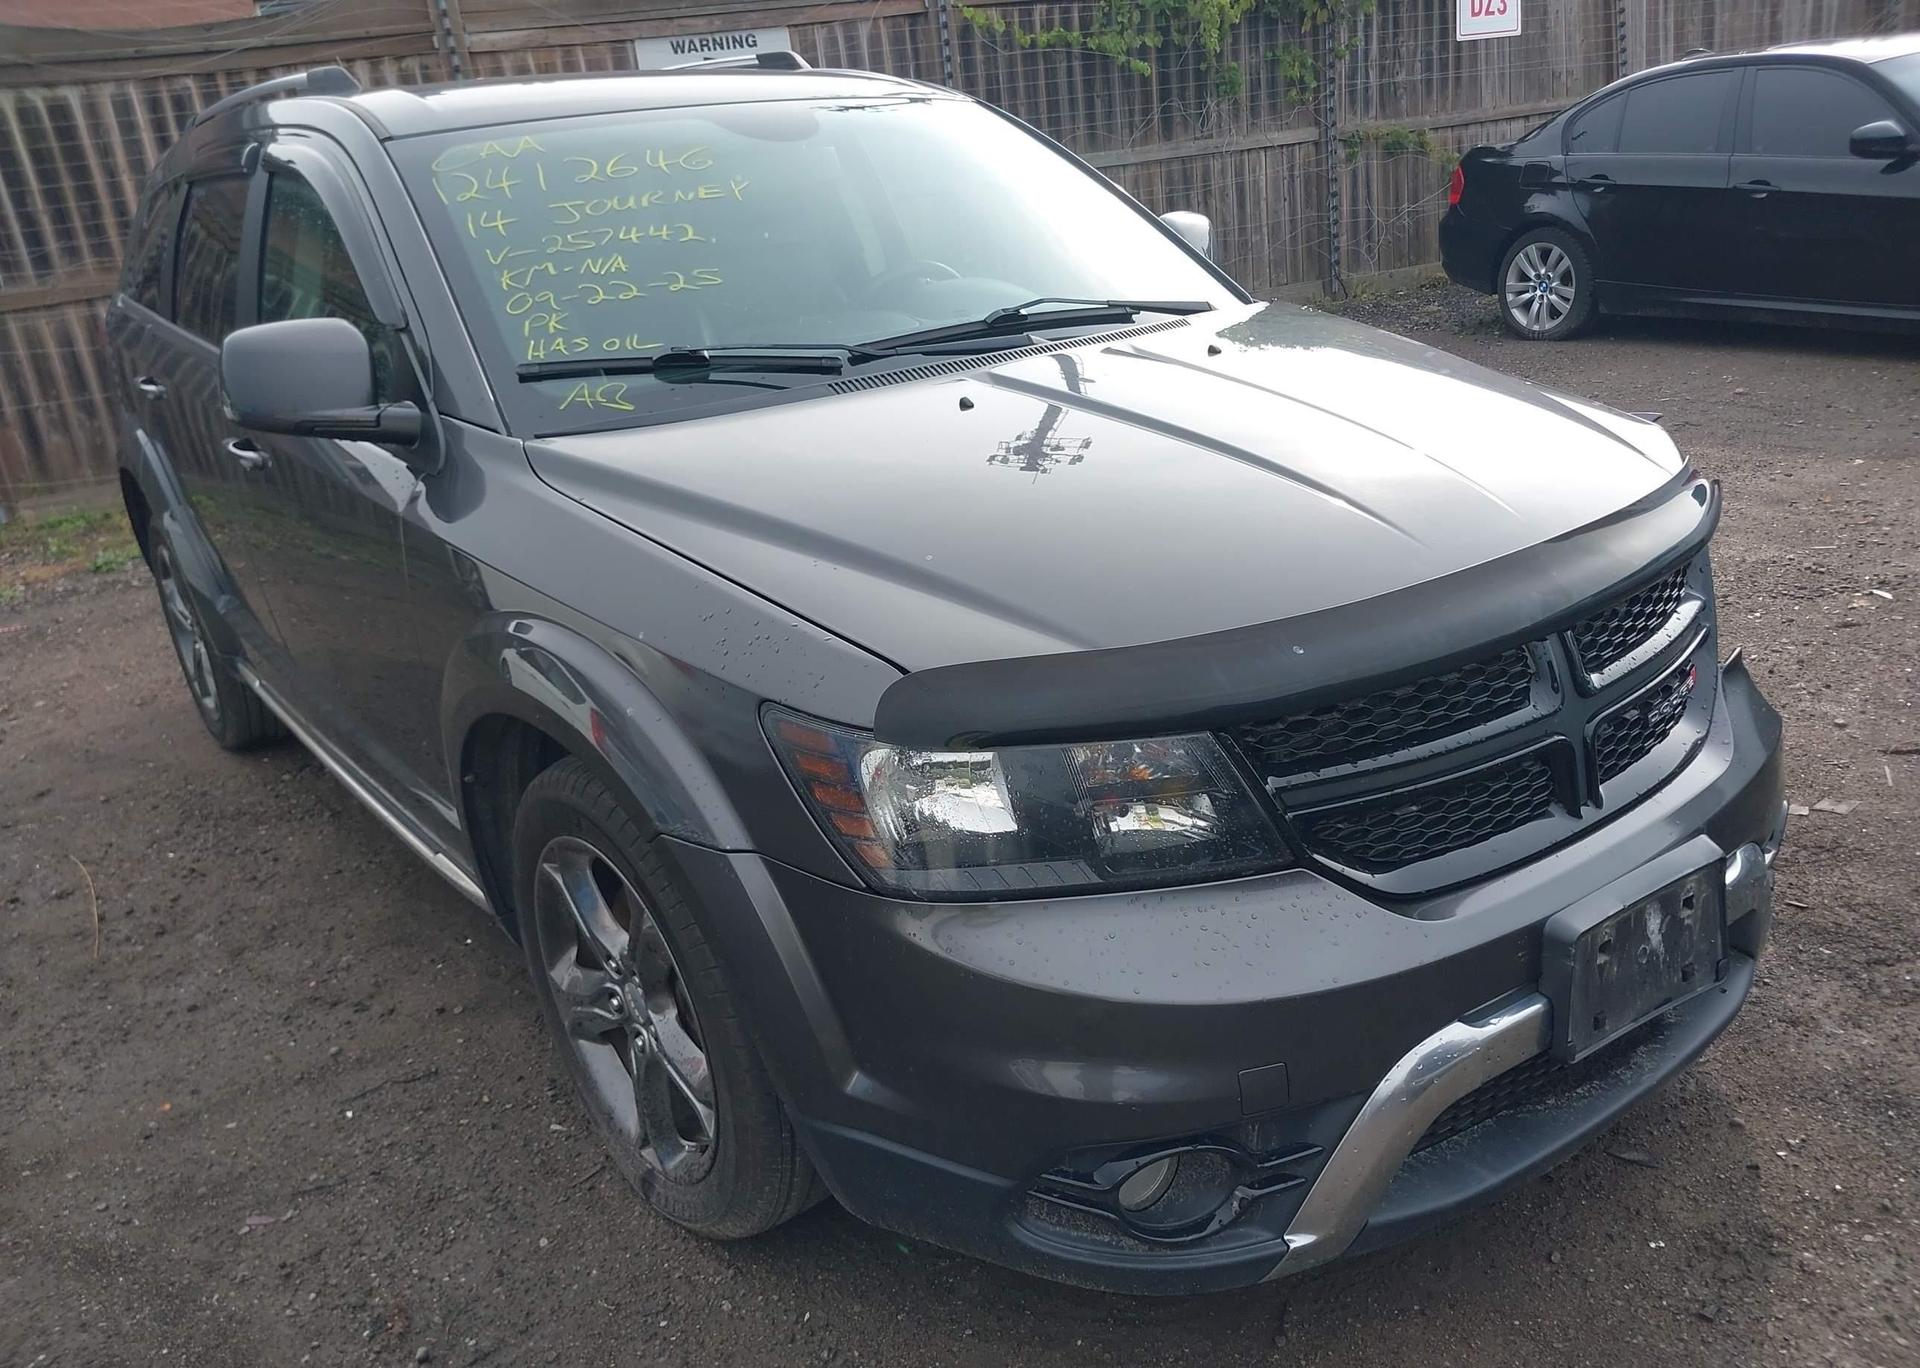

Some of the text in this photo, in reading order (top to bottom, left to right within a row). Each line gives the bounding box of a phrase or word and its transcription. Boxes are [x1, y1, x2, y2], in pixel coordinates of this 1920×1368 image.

[669, 33, 758, 55] WARNING
[467, 178, 751, 239] 14 JOURNEY
[506, 268, 723, 315] 09-22-25
[523, 311, 569, 336] PK
[527, 333, 665, 361] HAS OIL
